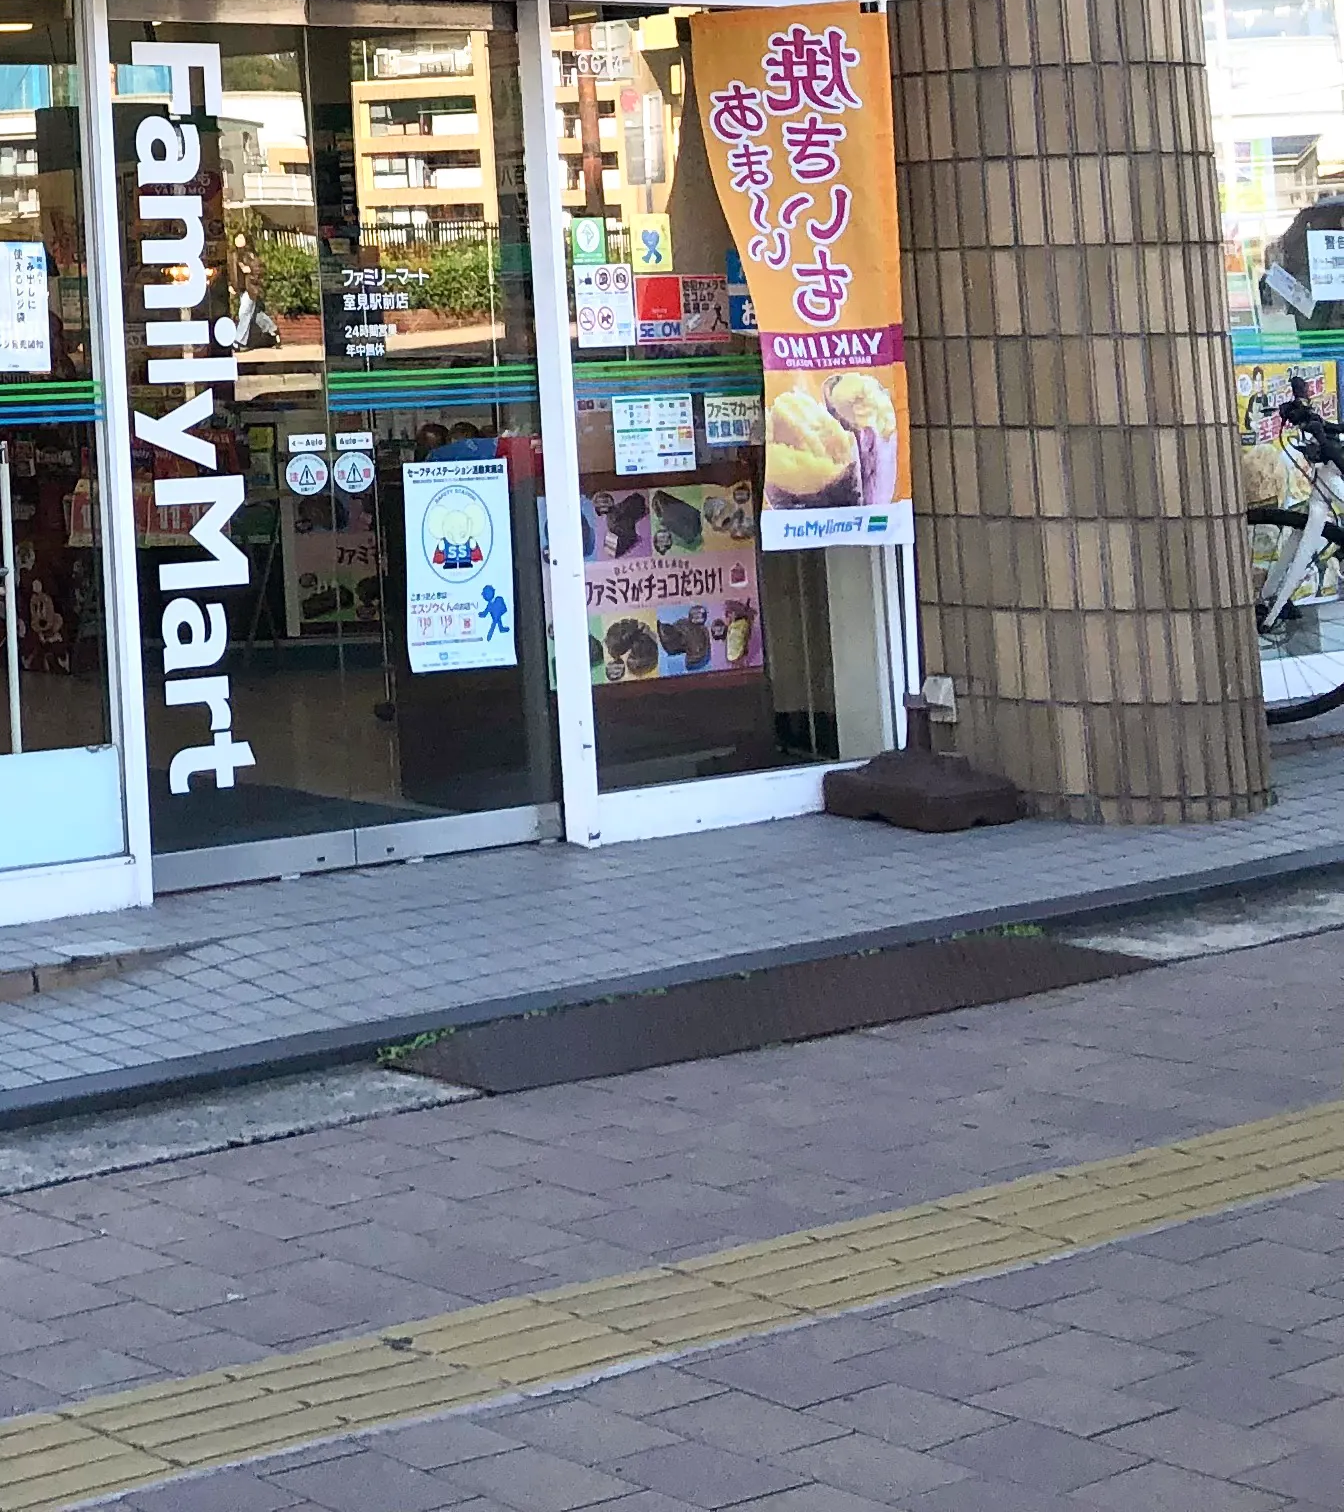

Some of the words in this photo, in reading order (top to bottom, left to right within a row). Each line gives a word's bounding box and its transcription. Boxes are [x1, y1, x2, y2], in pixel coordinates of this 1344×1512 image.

[341, 268, 430, 287] ファミリーマート
[343, 292, 409, 311] 室見駅前店
[131, 42, 255, 794] FamilyMart
[448, 545, 469, 559] SS
